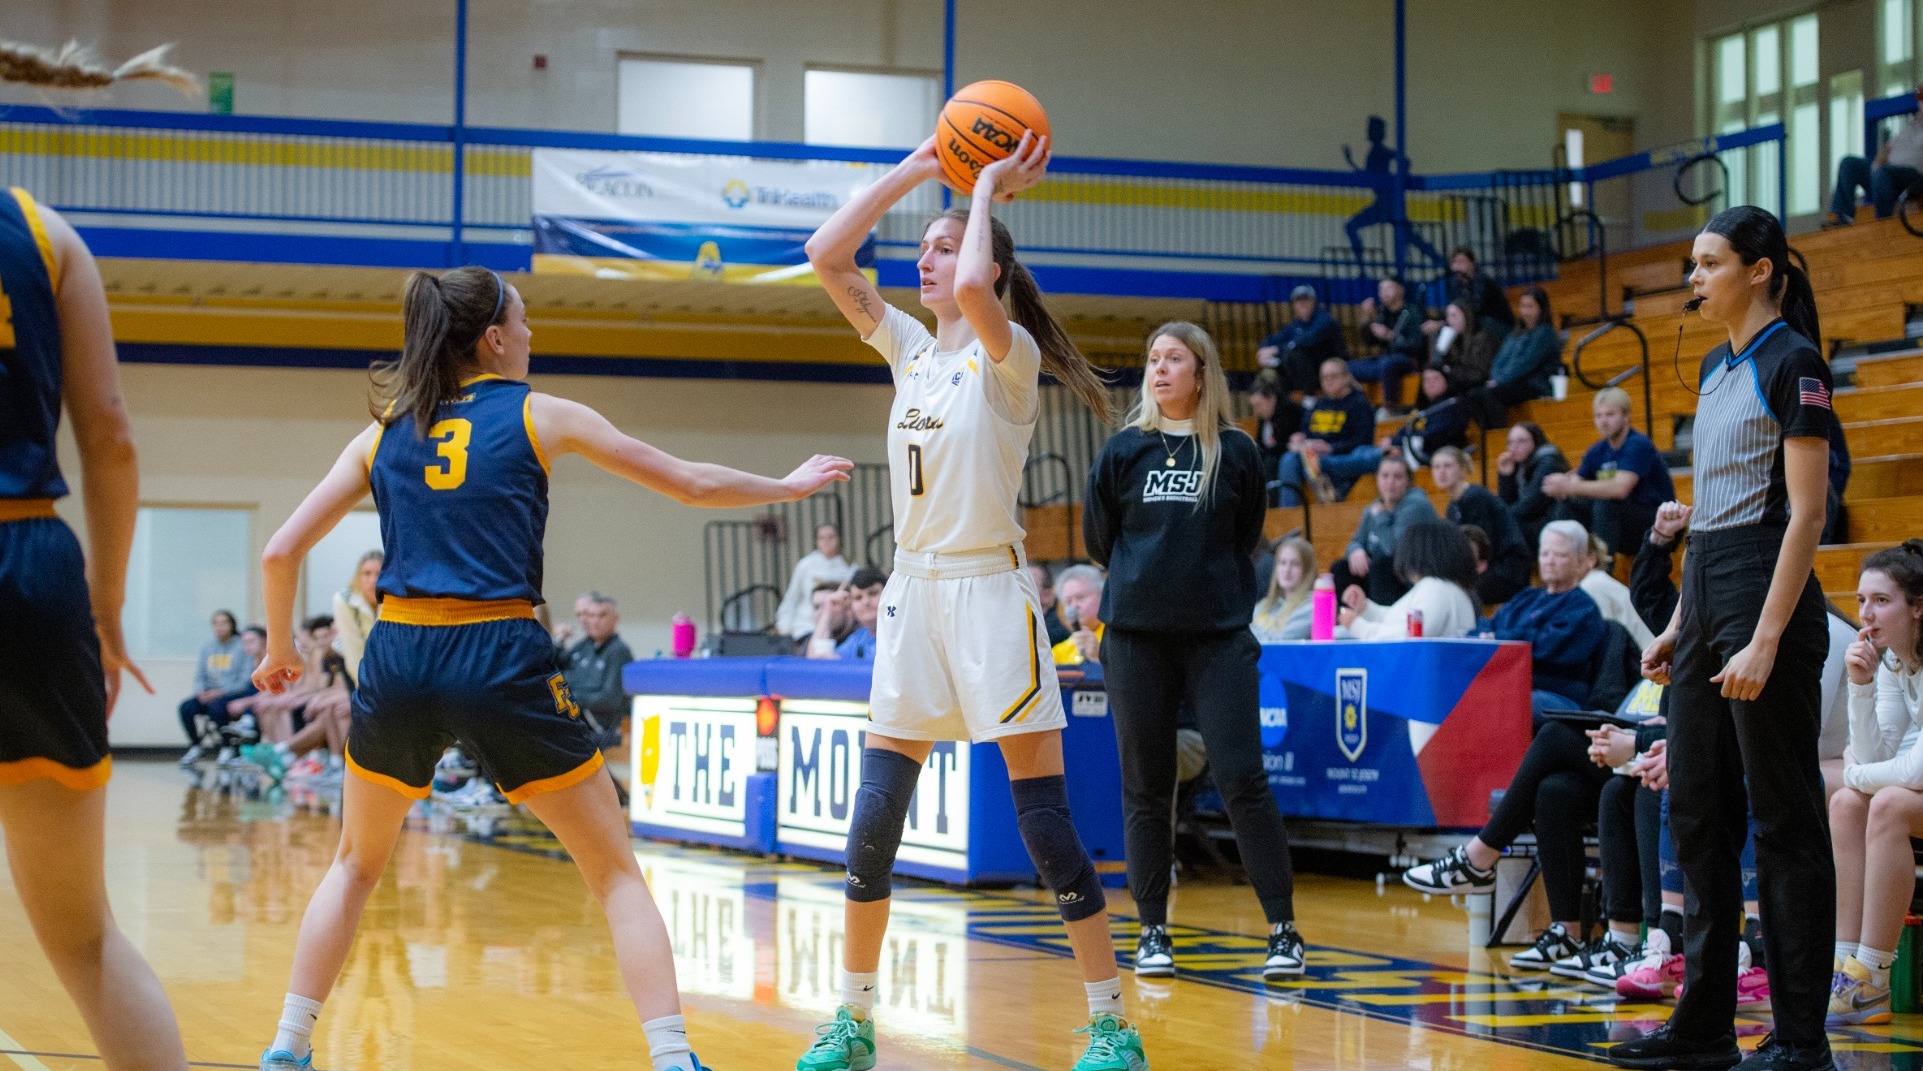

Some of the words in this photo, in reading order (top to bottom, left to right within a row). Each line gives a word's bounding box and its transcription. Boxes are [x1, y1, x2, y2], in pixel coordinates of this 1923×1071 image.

[424, 418, 472, 490] 3
[907, 444, 924, 496] 0
[1143, 470, 1205, 497] MSJ
[669, 721, 736, 807] THE
[790, 726, 956, 834] MOT
